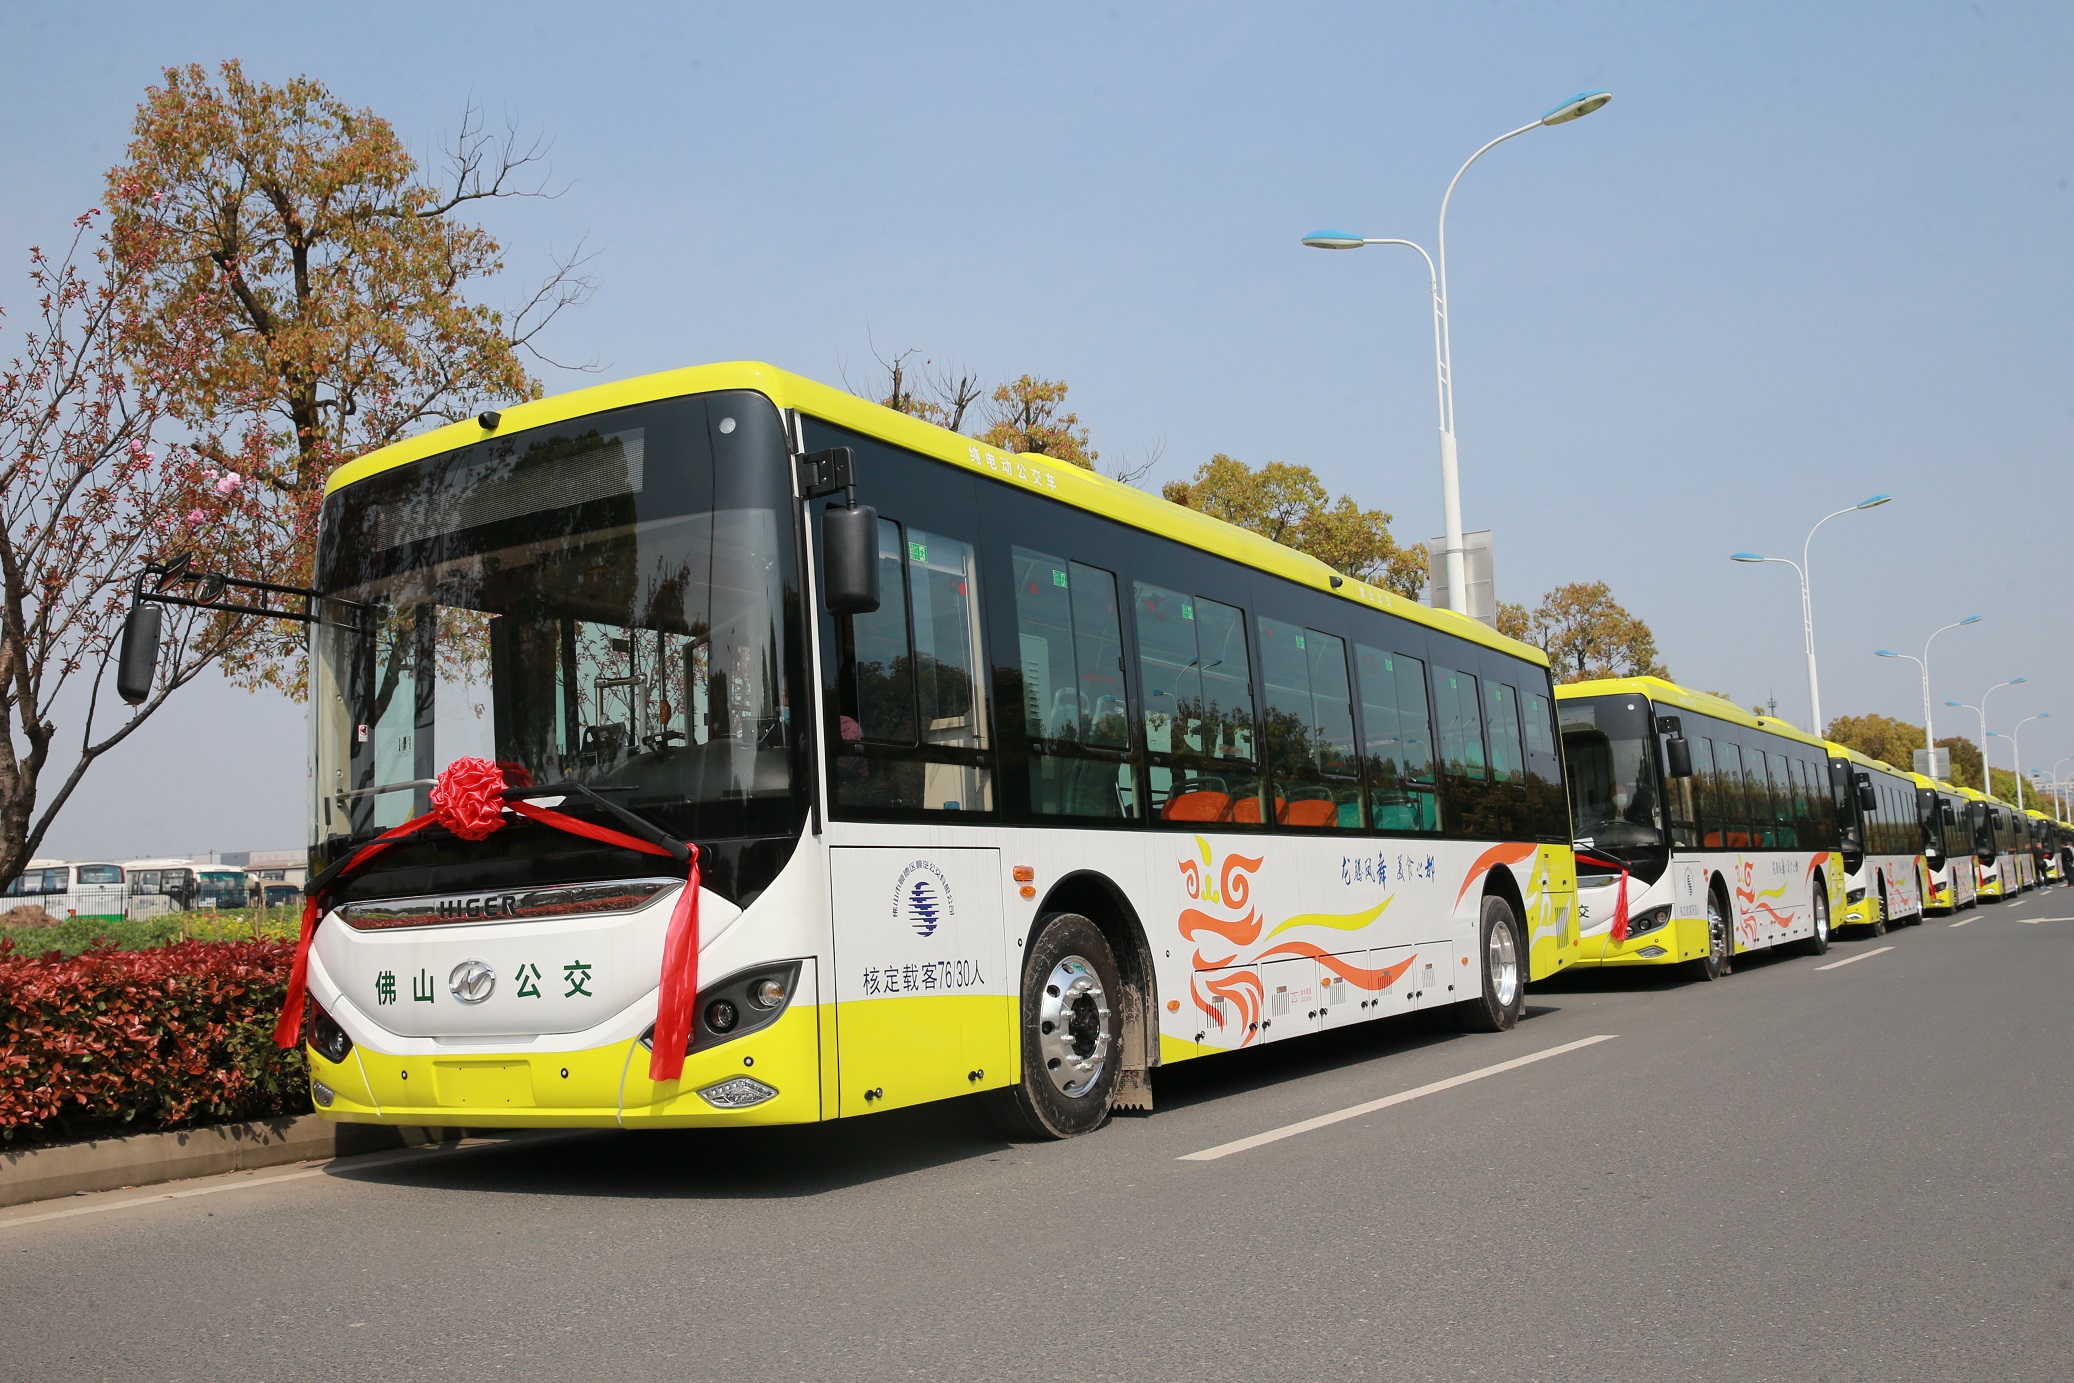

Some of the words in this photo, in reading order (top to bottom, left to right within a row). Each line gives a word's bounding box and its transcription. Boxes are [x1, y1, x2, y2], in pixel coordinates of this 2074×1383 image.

[968, 445, 1057, 491] 纯电动公交车
[440, 895, 516, 919] HIGER
[375, 967, 435, 1006] 佛山
[514, 959, 593, 999] 公交
[863, 959, 985, 996] 核定载客76/30人
